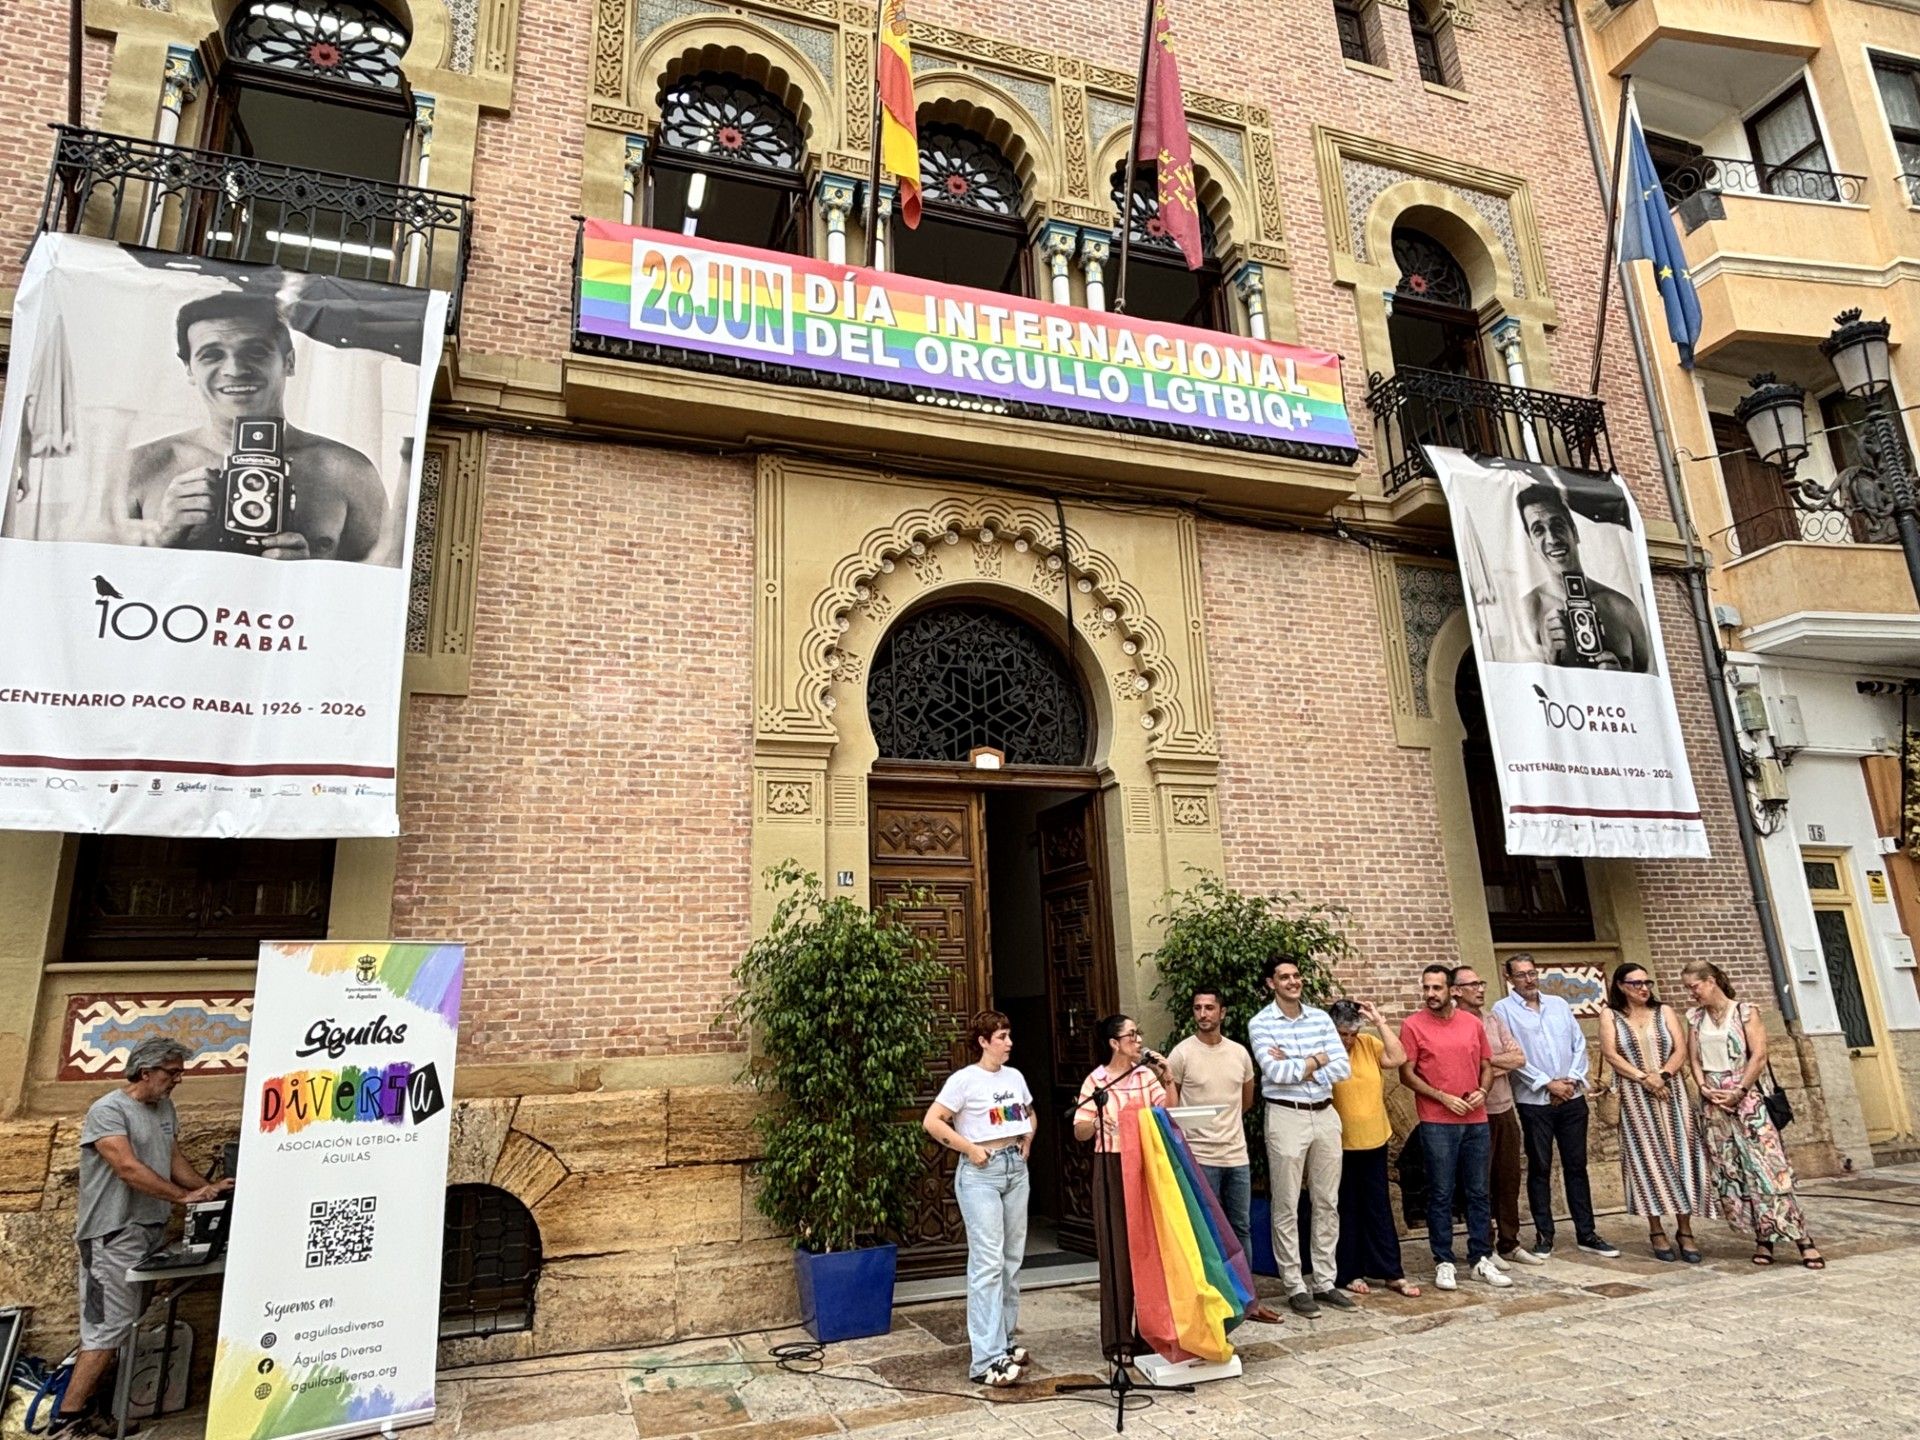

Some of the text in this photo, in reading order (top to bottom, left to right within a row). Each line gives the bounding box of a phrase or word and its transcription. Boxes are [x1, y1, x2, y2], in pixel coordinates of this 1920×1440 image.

[804, 272, 1310, 396] DÍA INTERNACIONAL
[805, 318, 1313, 431] DEL ORGULLO LGTBIQ+
[95, 599, 209, 644] 100
[215, 607, 296, 630] PACO
[213, 630, 308, 652] RABAL
[0, 688, 126, 708] CENTENARIO
[132, 694, 187, 710] PACO
[192, 697, 255, 716] RABAL
[262, 701, 302, 717] 1926
[320, 701, 367, 718] 2026
[1586, 705, 1626, 718] PACO
[1589, 721, 1638, 734] RABAL
[1508, 762, 1567, 774] CENTENARIO
[1568, 765, 1590, 775] PACO
[1591, 767, 1622, 777] RABAL
[1624, 767, 1646, 778] 1926
[839, 872, 853, 886] 14
[277, 1132, 419, 1153] ASOCIACIÓN LGTBIQ+ DE
[322, 1151, 371, 1165] ÁGUILAS
[294, 1320, 385, 1342] @aguilasdiversa
[292, 1343, 383, 1368] Águilas Diversa
[290, 1365, 398, 1394] aguilasdiversa.org
